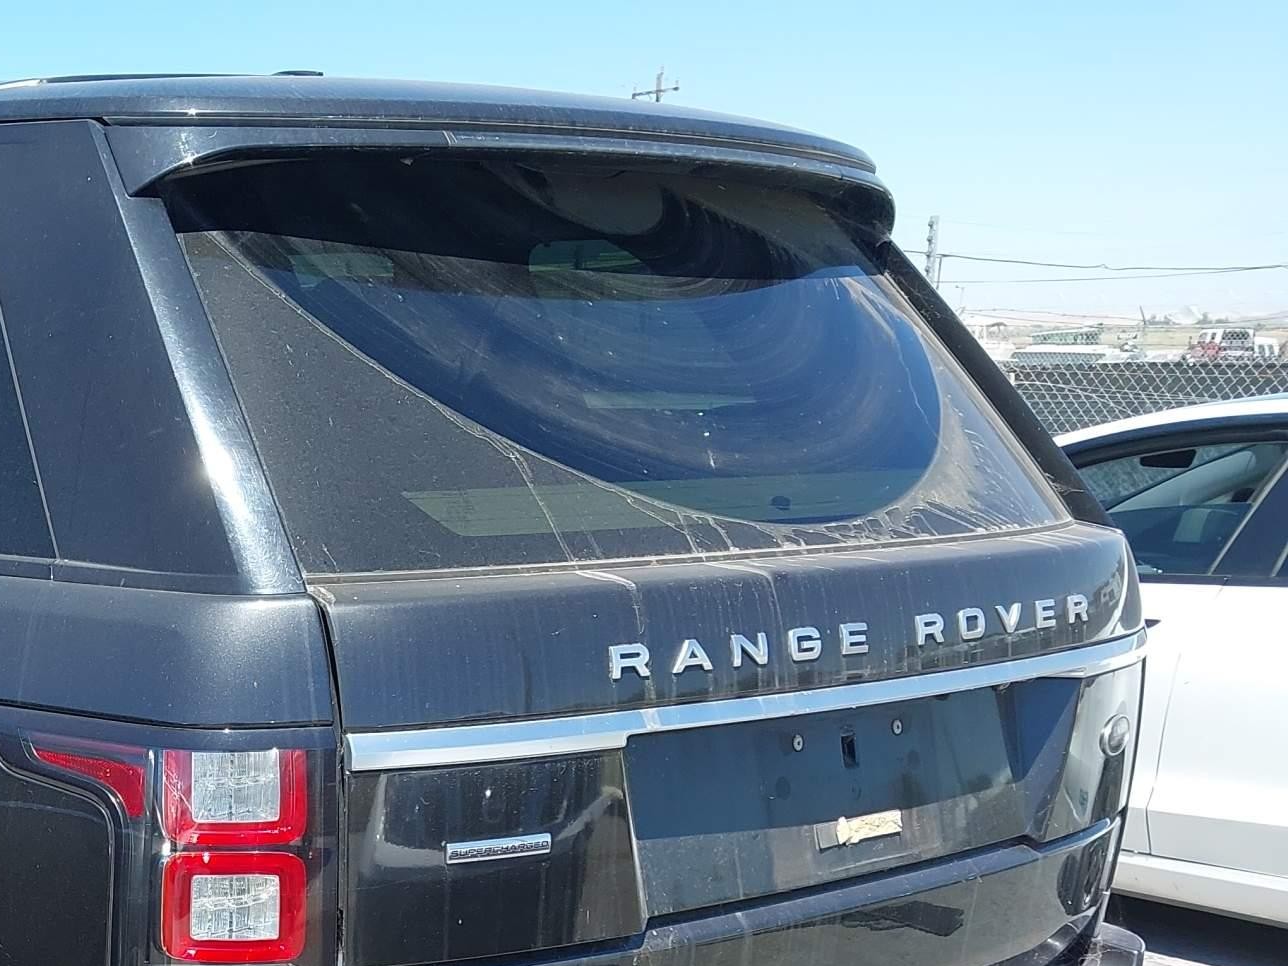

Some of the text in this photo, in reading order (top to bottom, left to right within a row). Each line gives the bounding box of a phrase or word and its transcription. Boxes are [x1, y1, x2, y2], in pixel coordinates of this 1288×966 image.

[609, 594, 1089, 680] RANGE ROVER
[450, 840, 550, 859] SUPERCHARGED
